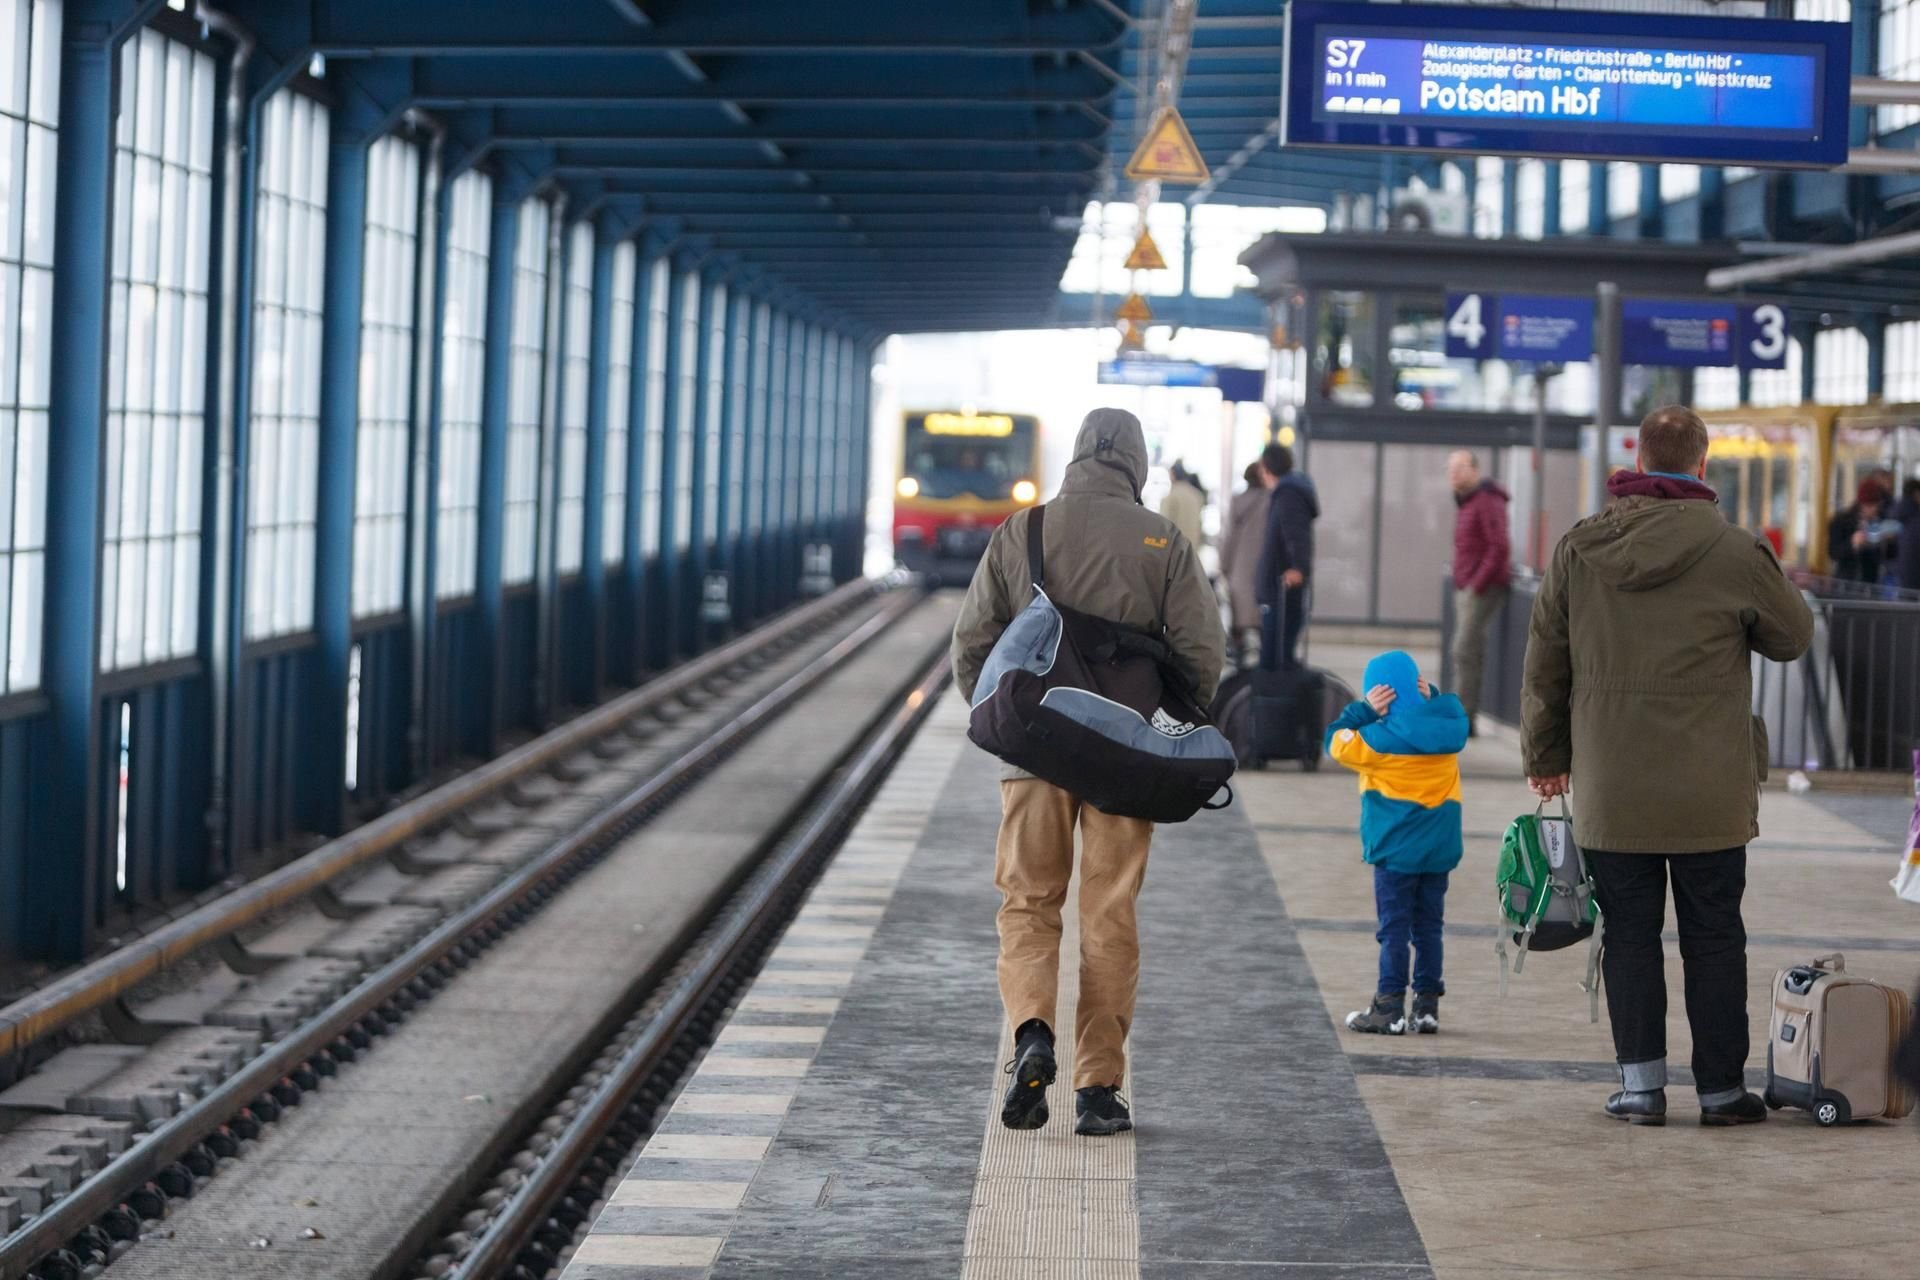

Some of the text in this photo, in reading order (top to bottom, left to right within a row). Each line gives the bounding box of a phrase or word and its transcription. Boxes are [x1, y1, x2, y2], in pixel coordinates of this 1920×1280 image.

[1327, 39, 1366, 68] S7
[1423, 43, 1732, 70] Alexanderplatz Friedrichstraße Berlin Hbf
[1326, 70, 1386, 88] in 1 min
[1421, 60, 1772, 89] Zoologischer Garten Charlottenburg Westkreuz
[1420, 80, 1601, 116] Potsdam Hbf
[1449, 293, 1486, 349] 4
[1750, 303, 1785, 361] 3
